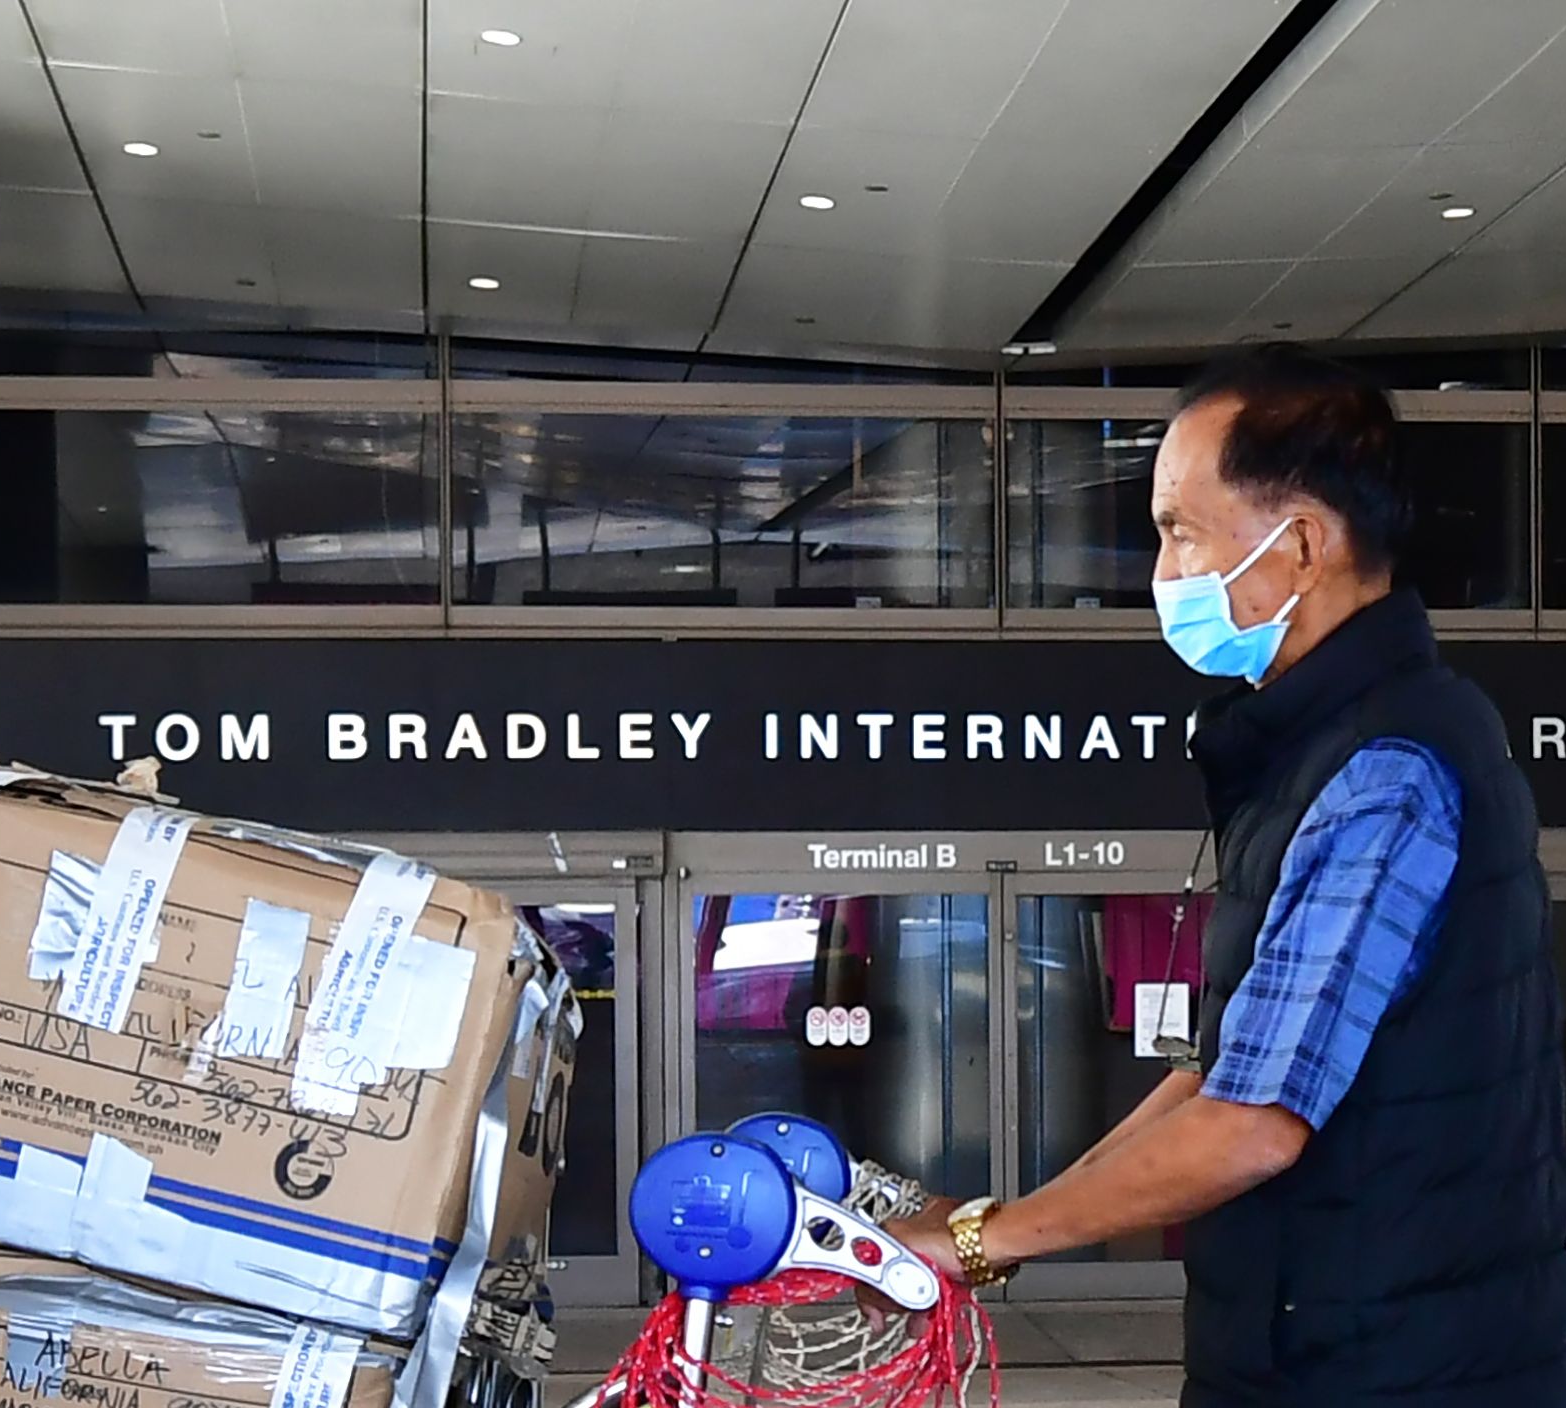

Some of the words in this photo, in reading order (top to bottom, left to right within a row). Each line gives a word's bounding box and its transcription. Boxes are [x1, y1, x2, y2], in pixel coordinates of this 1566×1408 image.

[98, 713, 270, 760] TOM
[328, 713, 711, 760] BRADLEY
[765, 712, 1197, 760] INTERNATI
[807, 844, 928, 869] Terminal
[936, 844, 957, 868] B
[1045, 841, 1124, 866] L1-10
[129, 878, 157, 935] OPENED
[117, 938, 138, 967] FOR
[375, 914, 404, 970] OPENED
[99, 968, 127, 1031] INSPECT
[40, 1086, 97, 1114] PAPER
[101, 1102, 222, 1147] CORPORATION
